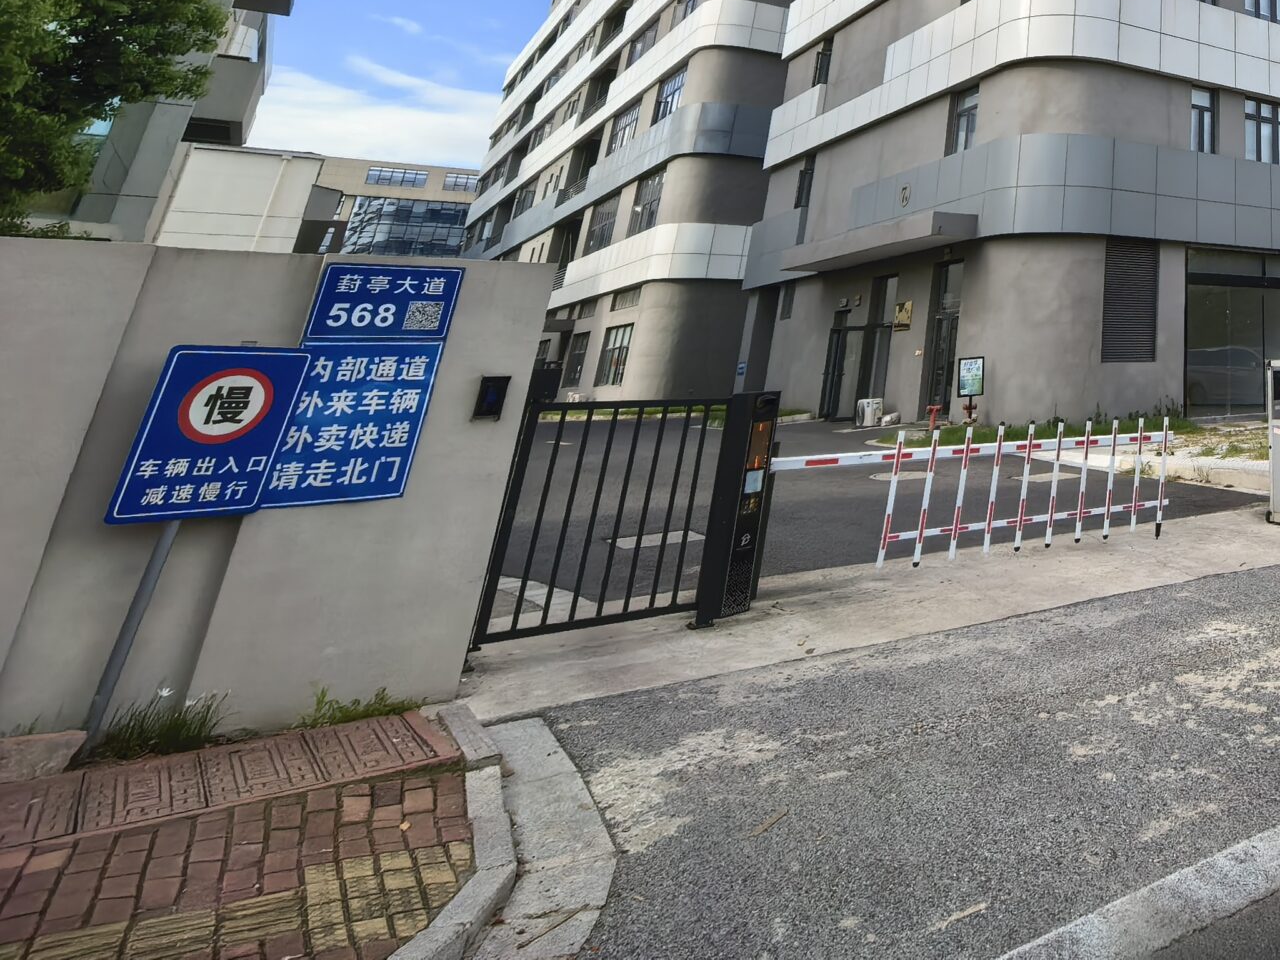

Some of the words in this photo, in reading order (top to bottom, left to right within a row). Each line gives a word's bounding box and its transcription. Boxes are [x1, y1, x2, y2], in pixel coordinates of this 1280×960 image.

[335, 273, 447, 295] 葑亭大道
[326, 302, 397, 328] 568
[310, 355, 430, 383] 内部通道
[203, 385, 254, 425] 慢
[295, 388, 422, 418] 外来车辆
[281, 420, 411, 454] 外卖快递
[136, 455, 268, 479] 车辆出入口
[268, 456, 402, 491] 请走北门
[140, 480, 248, 506] 减速慢行
